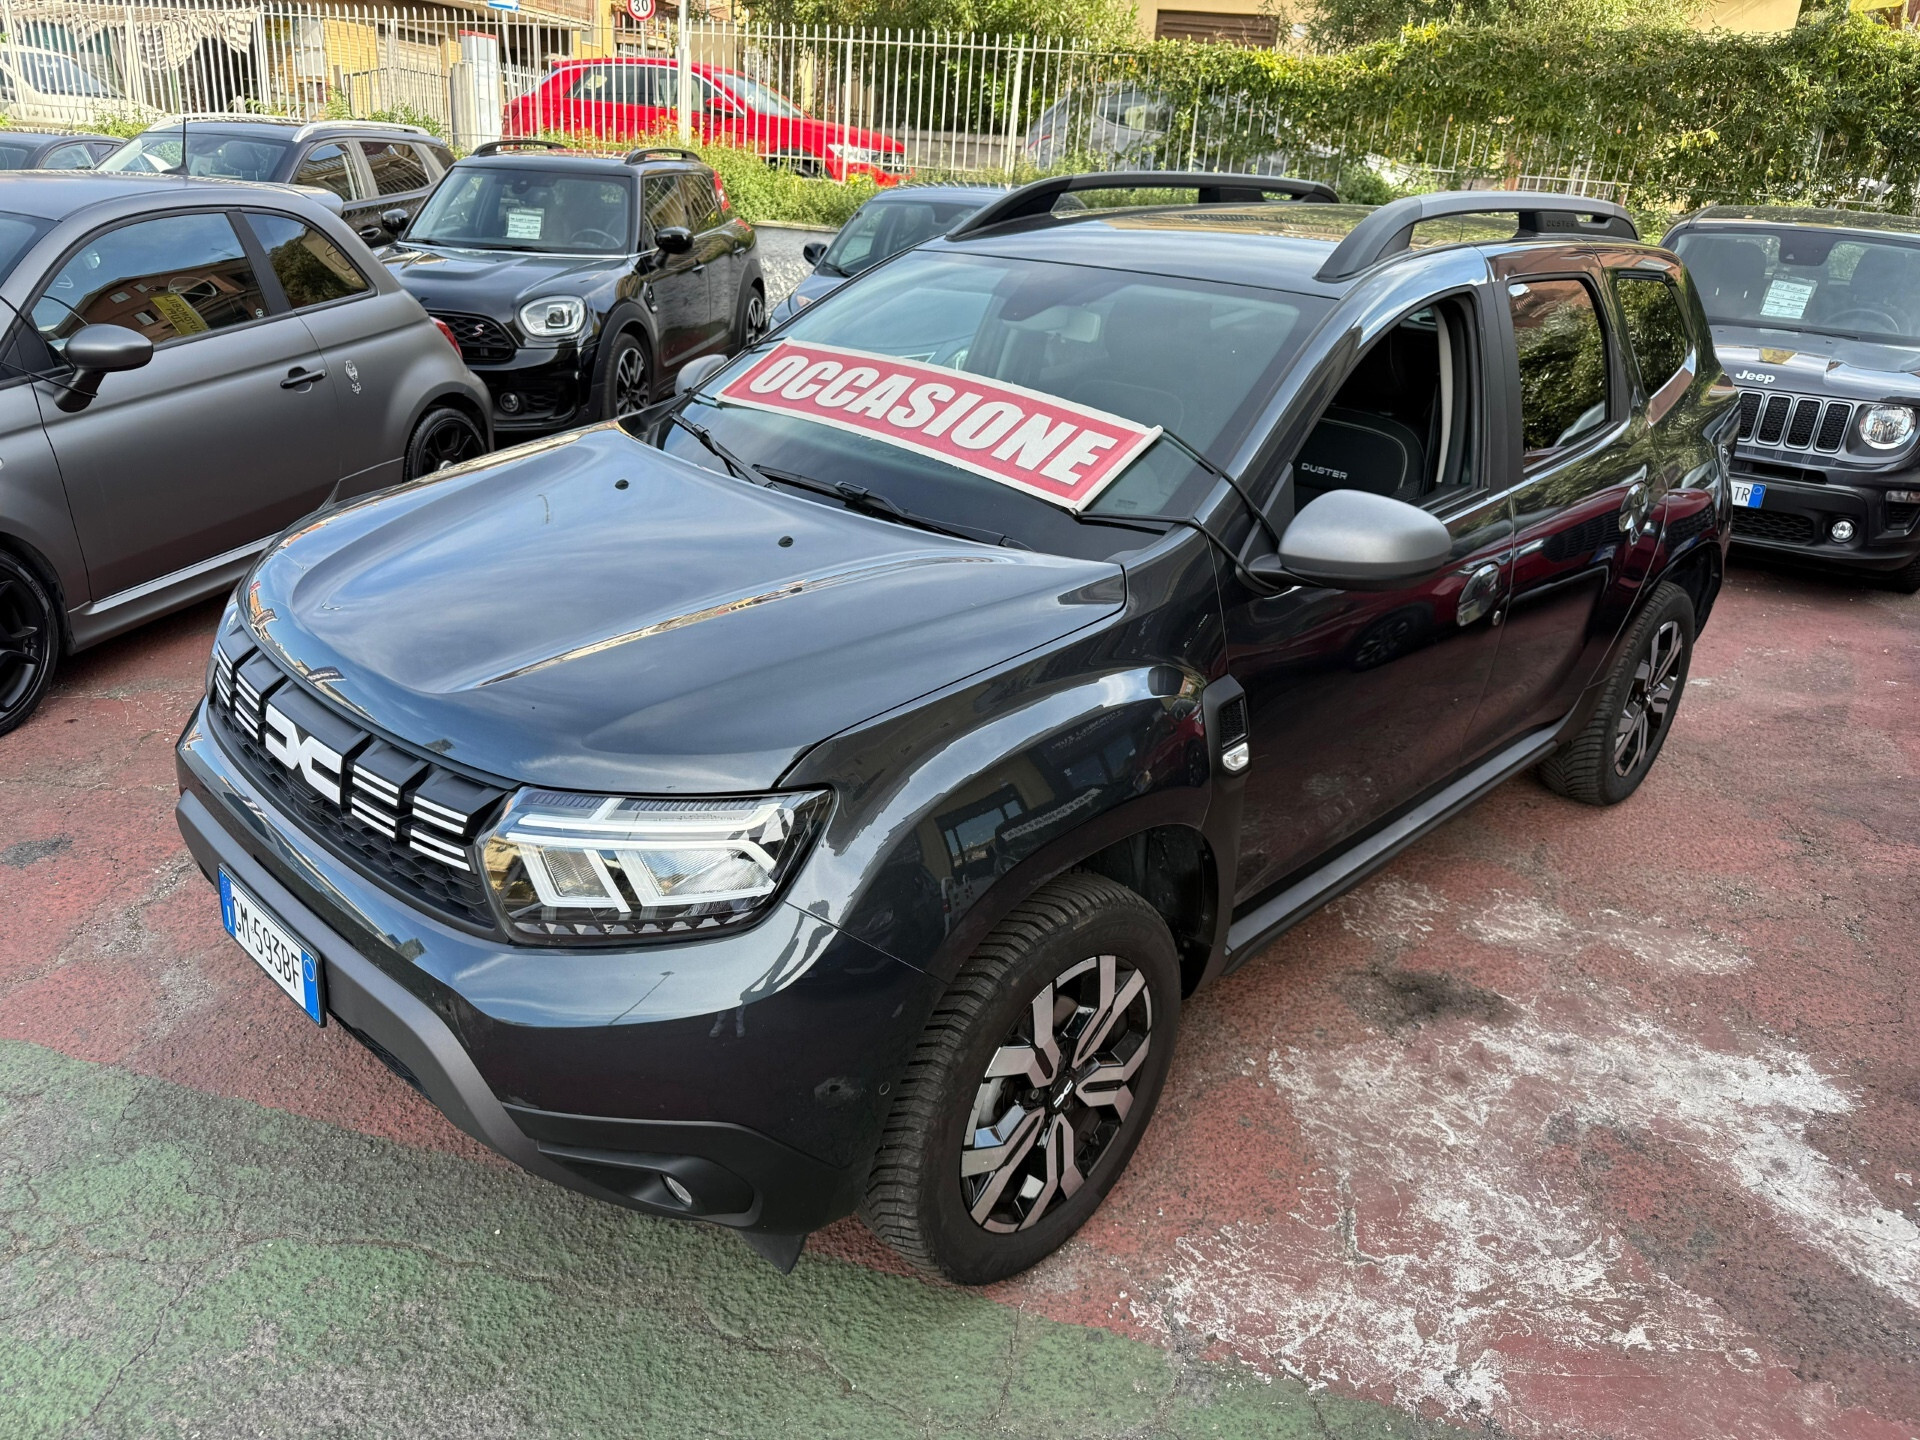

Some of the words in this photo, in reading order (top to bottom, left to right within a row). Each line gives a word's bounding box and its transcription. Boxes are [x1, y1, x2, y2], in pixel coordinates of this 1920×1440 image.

[633, 0, 649, 12] 30
[1735, 370, 1775, 384] Jeep
[749, 355, 1118, 486] OCCASIONE
[1301, 462, 1348, 480] DUSTER
